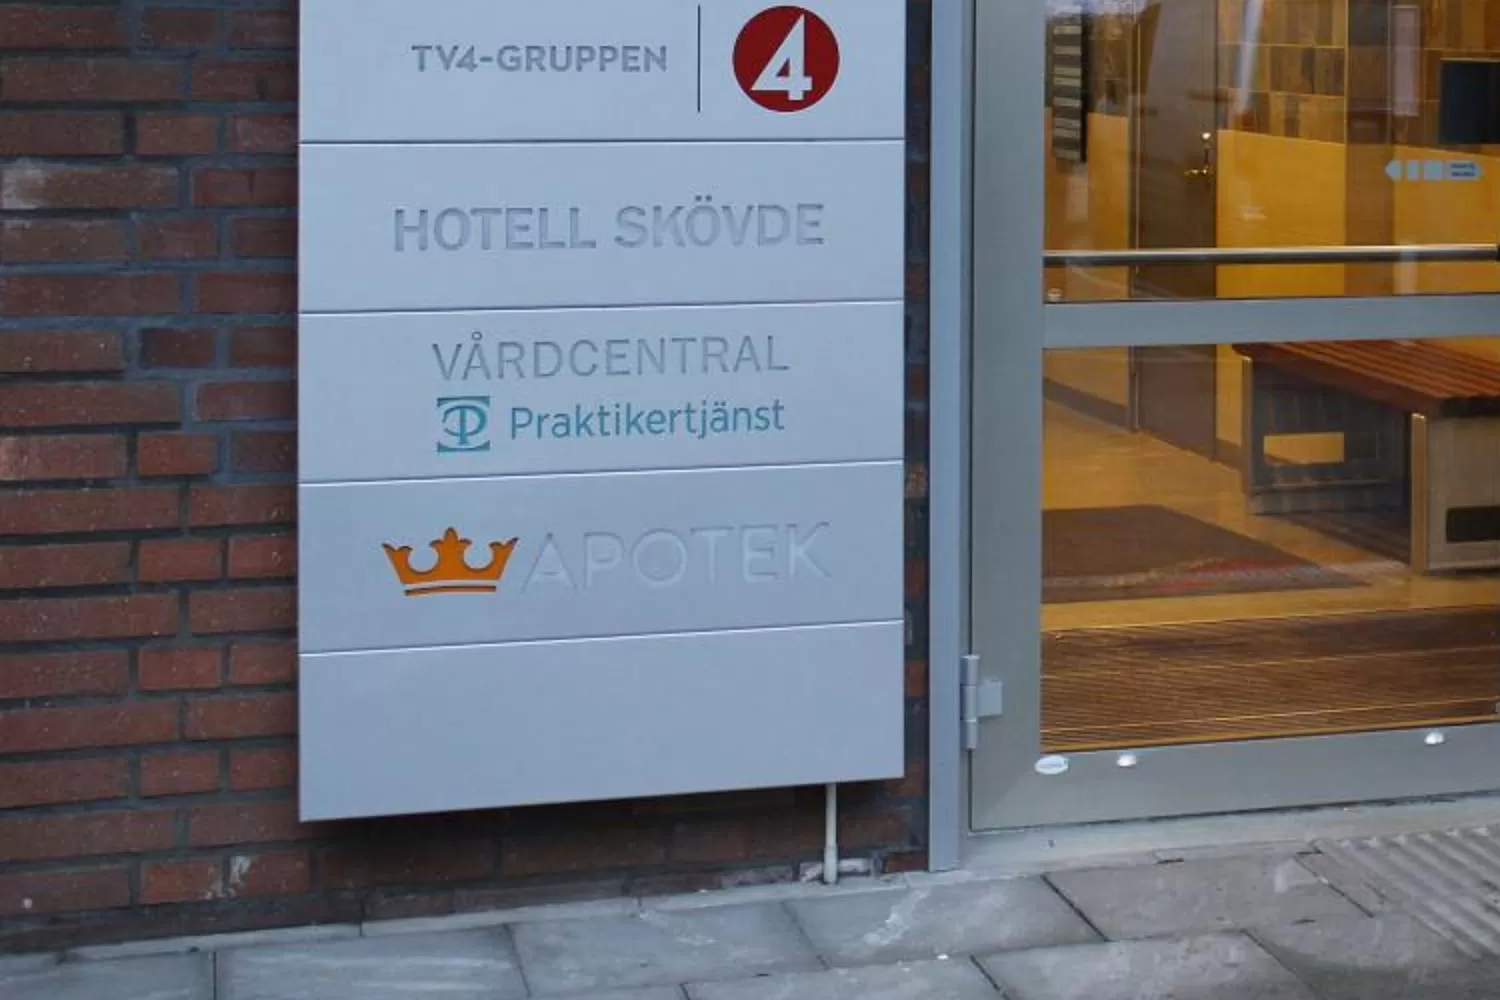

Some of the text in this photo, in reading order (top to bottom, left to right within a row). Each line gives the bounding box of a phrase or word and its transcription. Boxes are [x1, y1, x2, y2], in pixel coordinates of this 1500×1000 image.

[411, 44, 668, 74] TV4-GRUPPEN
[393, 194, 825, 252] HOTELL SKÖVDE
[431, 330, 791, 381] VÅRDCENTRAL
[510, 398, 785, 441] Praktikertjänst
[520, 520, 833, 594] APOTEK
